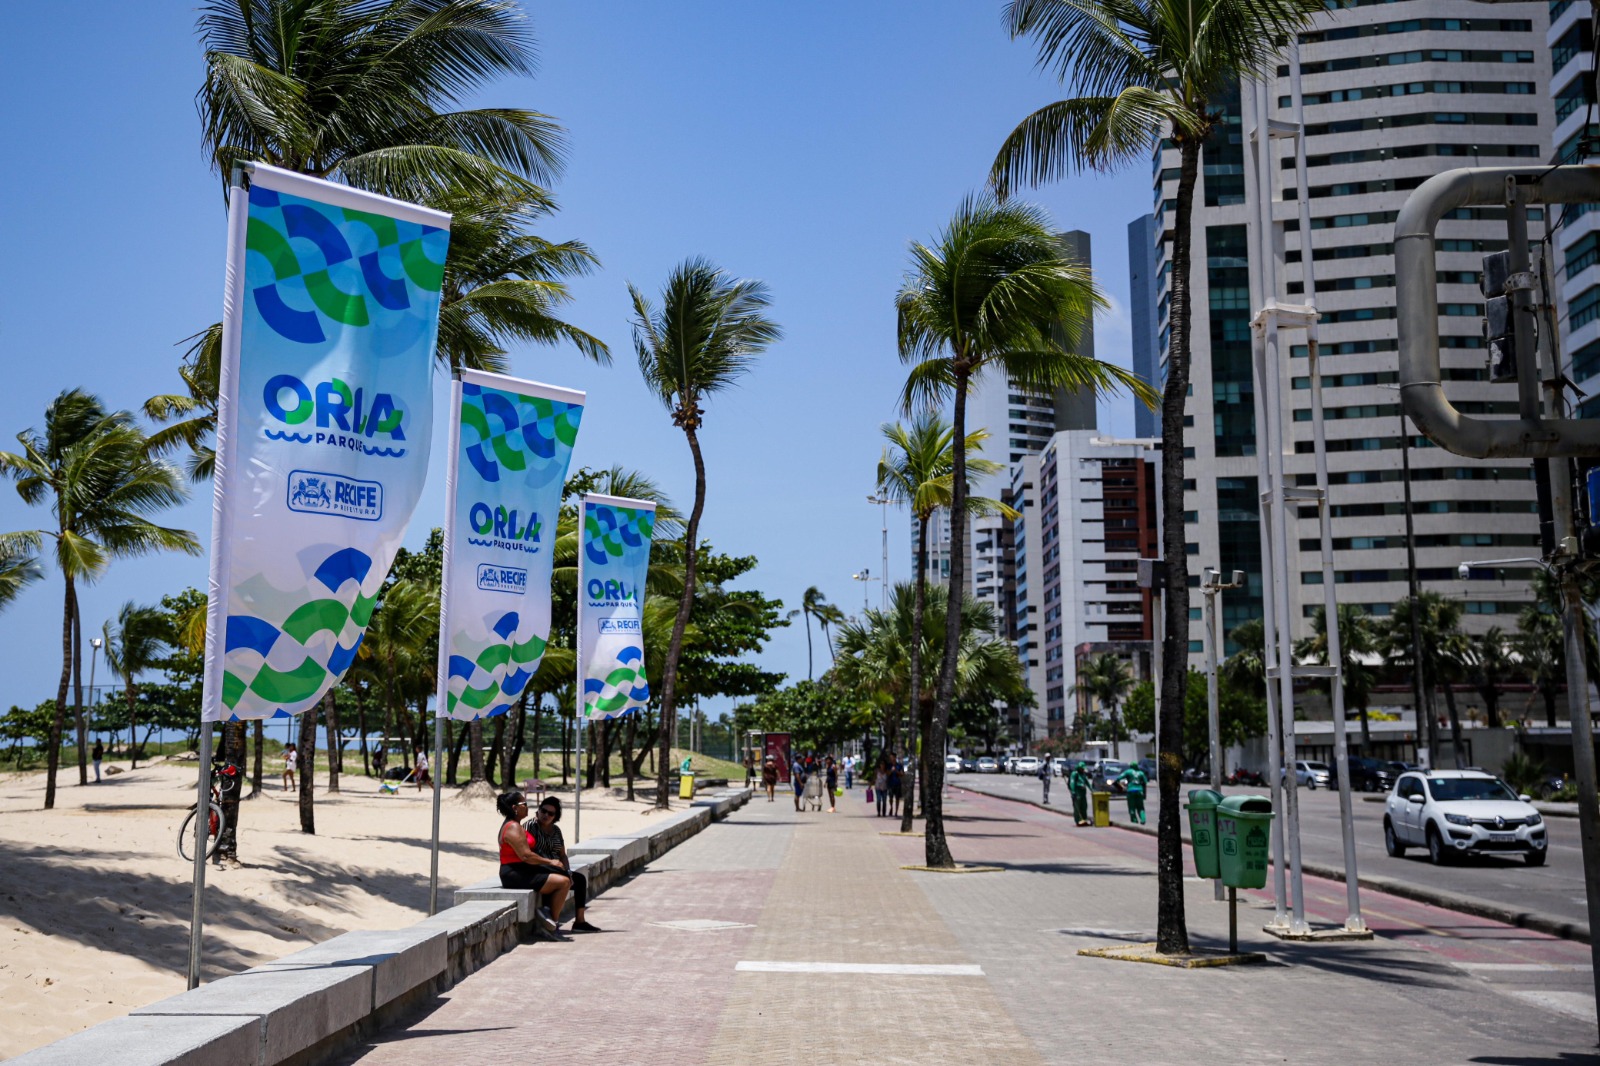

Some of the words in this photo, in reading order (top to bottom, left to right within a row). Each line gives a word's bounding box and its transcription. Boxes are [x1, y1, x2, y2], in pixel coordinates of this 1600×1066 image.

[315, 432, 363, 452] PARQUE
[335, 481, 377, 508] RECIFE
[469, 502, 541, 543] ORLA
[493, 539, 523, 551] PARQUE
[500, 570, 526, 586] RECIFE
